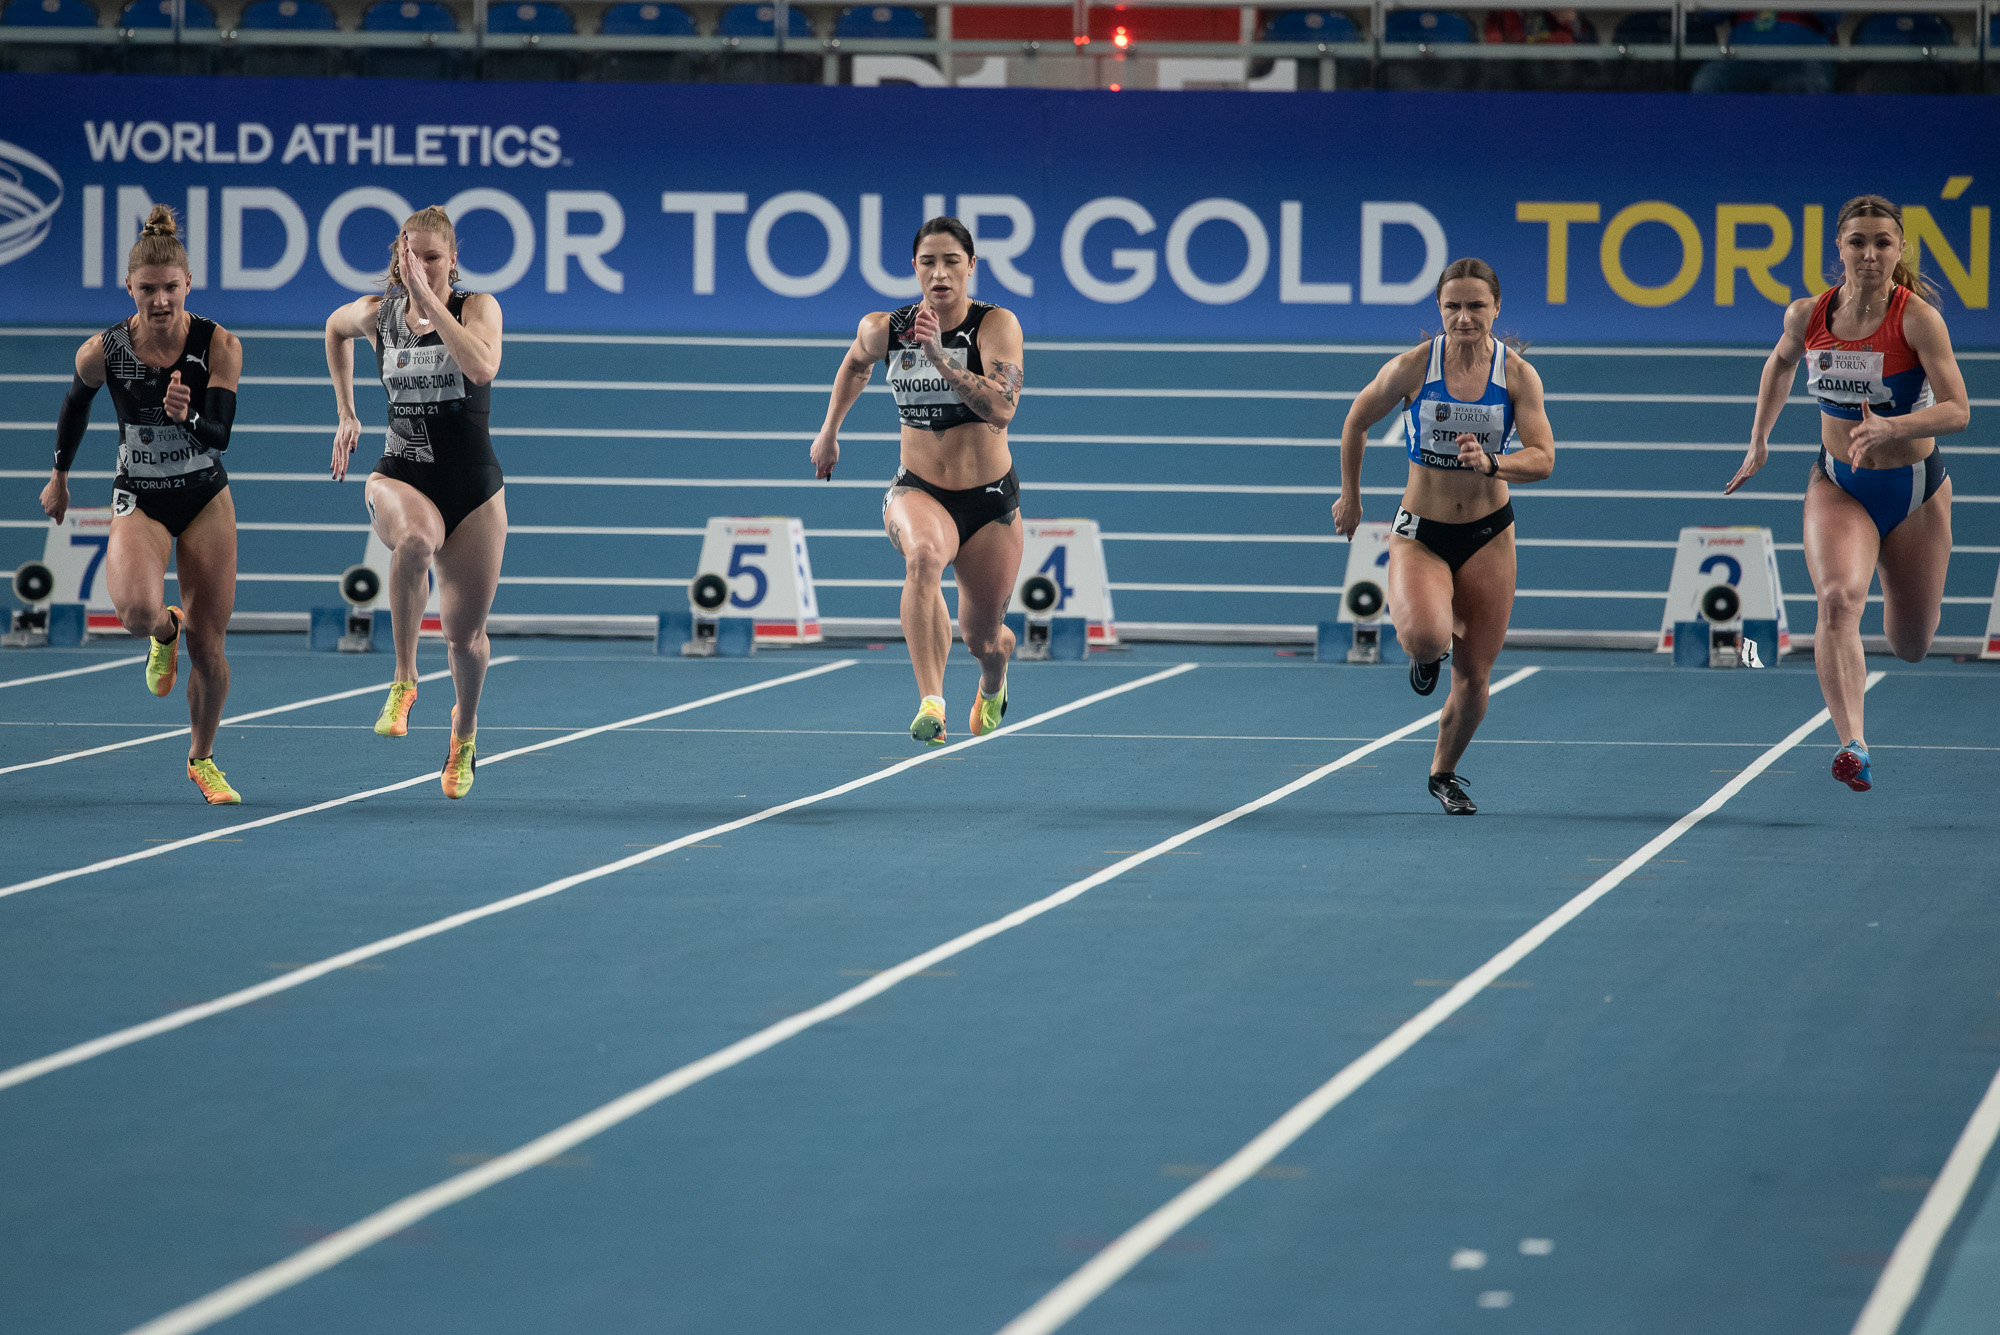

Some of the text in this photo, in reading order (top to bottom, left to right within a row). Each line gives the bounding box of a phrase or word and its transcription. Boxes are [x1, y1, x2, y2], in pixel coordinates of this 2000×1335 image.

[84, 121, 562, 168] WORLD ATHLETICS
[82, 185, 624, 295] INDOOR
[662, 190, 1034, 299] TOUR
[1060, 195, 1448, 305] GOLD
[412, 352, 444, 365] TORUŃ
[1835, 359, 1867, 370] TORUŃ
[389, 374, 456, 390] MIHALINEC-ZIDAR
[892, 378, 954, 392] SWOBOD
[1818, 378, 1873, 394] ADAMEK
[394, 404, 439, 416] TORUŃ 21
[899, 405, 942, 417] ORUŃ 21
[1453, 411, 1490, 423] TORUŃ
[1433, 429, 1491, 444] STRIK
[132, 446, 203, 465] DEL PONT
[1422, 452, 1458, 468] TORUŃ
[135, 478, 186, 489] TORUŃ 21
[116, 492, 130, 514] 5
[1395, 509, 1412, 537] 2
[70, 535, 109, 600] 7
[727, 543, 768, 609] 5
[1037, 545, 1074, 611] 4
